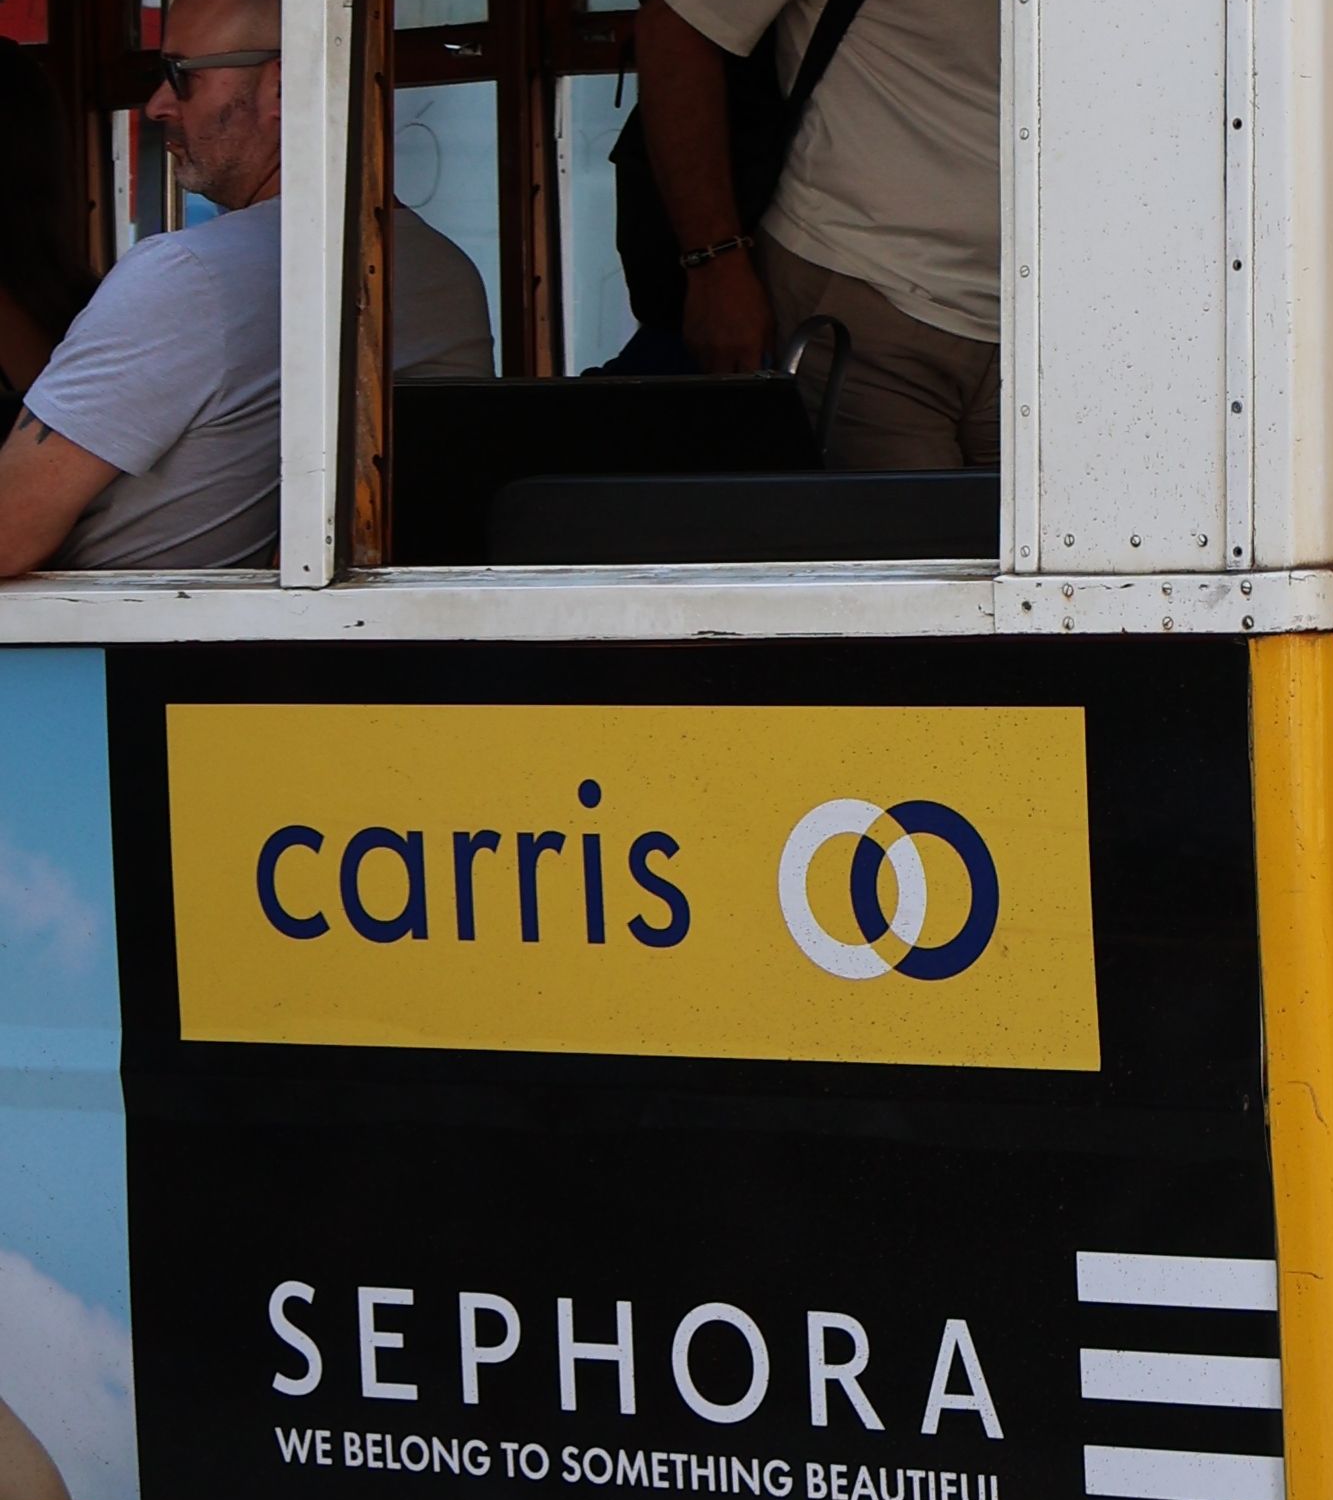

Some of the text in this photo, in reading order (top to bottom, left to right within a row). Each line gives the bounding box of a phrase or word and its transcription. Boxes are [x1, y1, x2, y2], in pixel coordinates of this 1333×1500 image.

[256, 778, 692, 949] carris
[268, 1279, 1005, 1440] SEPHORA
[274, 1426, 333, 1467] WE
[343, 1430, 491, 1478] BELONG
[500, 1441, 550, 1481] TO
[560, 1444, 793, 1498] SOMETHING
